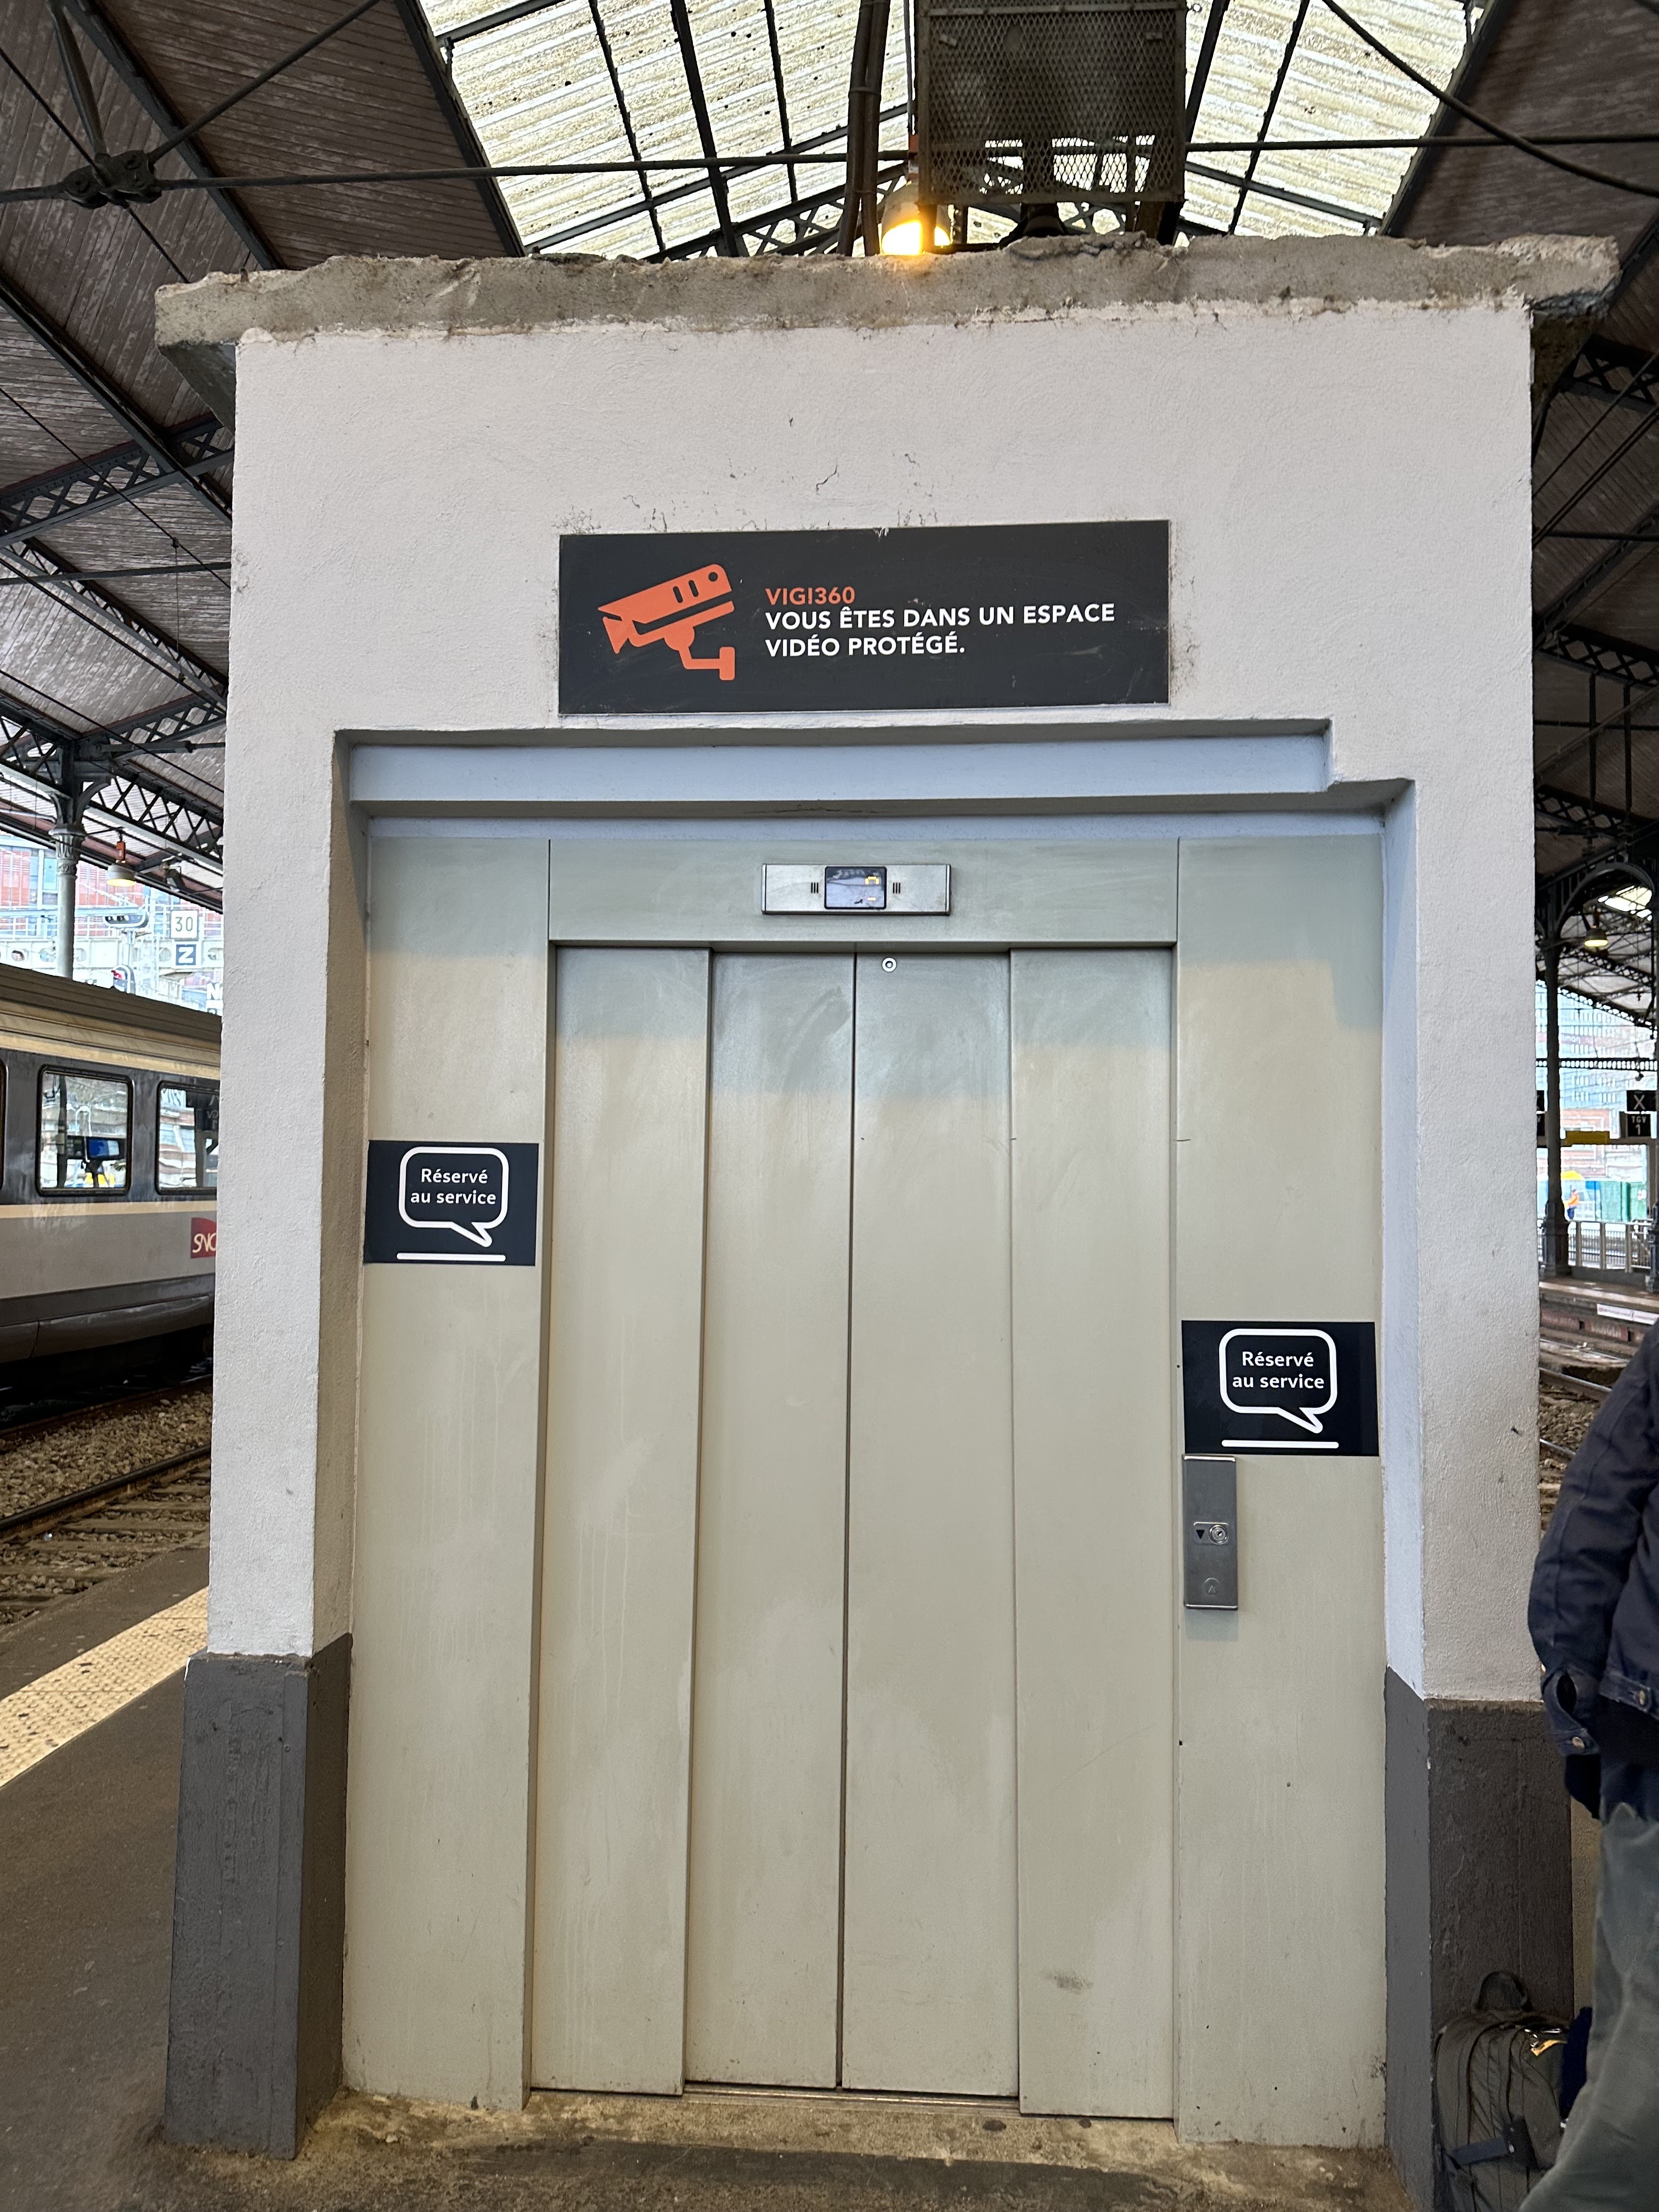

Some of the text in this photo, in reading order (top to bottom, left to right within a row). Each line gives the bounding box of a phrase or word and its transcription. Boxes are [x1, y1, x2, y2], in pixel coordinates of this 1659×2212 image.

[765, 586, 855, 605] VIGI360
[765, 603, 1115, 630] VOUS ÊTES DANS UN ESPACE
[765, 630, 965, 657] VIDÉO PROTÉGÉ.
[175, 916, 193, 932] 30
[178, 946, 194, 963] Z
[1633, 1094, 1645, 1110] X
[1635, 1124, 1640, 1135] 1
[421, 1168, 488, 1184] Réservé
[410, 1189, 496, 1205] au service
[1242, 1351, 1314, 1367] Réservé
[1232, 1373, 1324, 1389] au service
